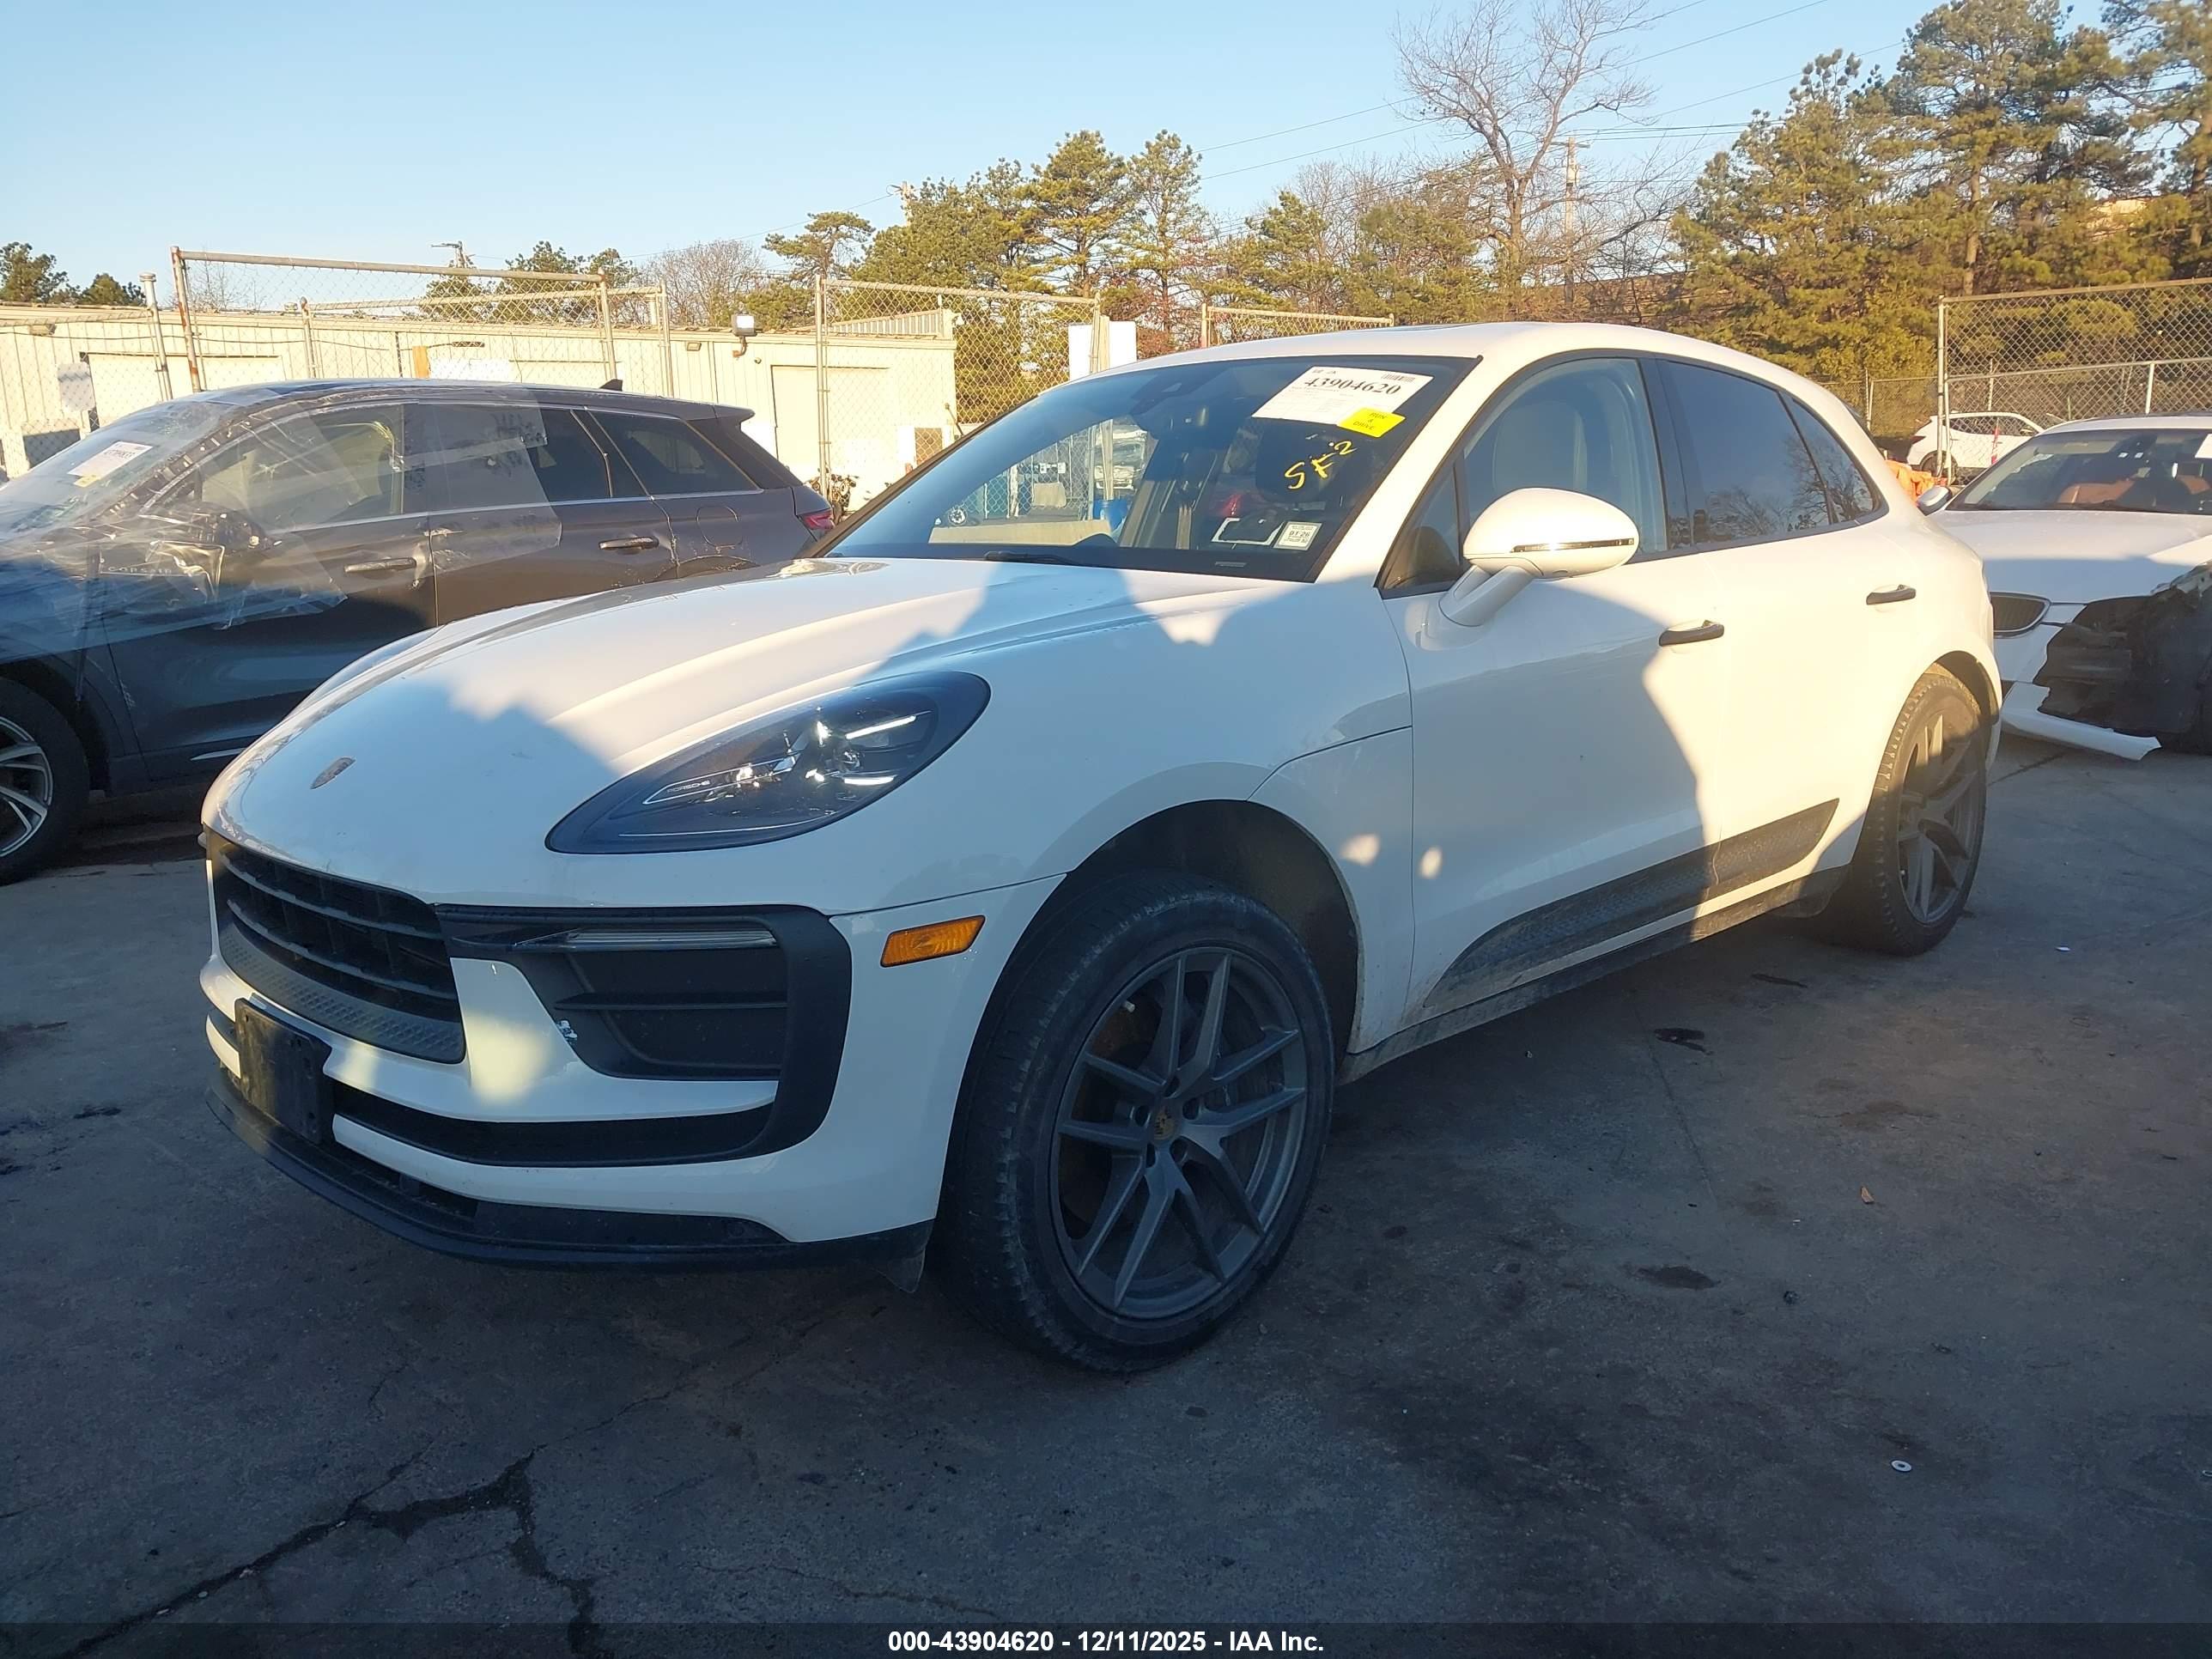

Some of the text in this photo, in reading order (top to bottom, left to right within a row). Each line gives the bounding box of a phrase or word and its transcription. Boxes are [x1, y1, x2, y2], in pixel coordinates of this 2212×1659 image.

[1304, 377, 1401, 395] 43904620
[1352, 421, 1375, 430] DRIVE
[666, 780, 711, 793] PORSCHE
